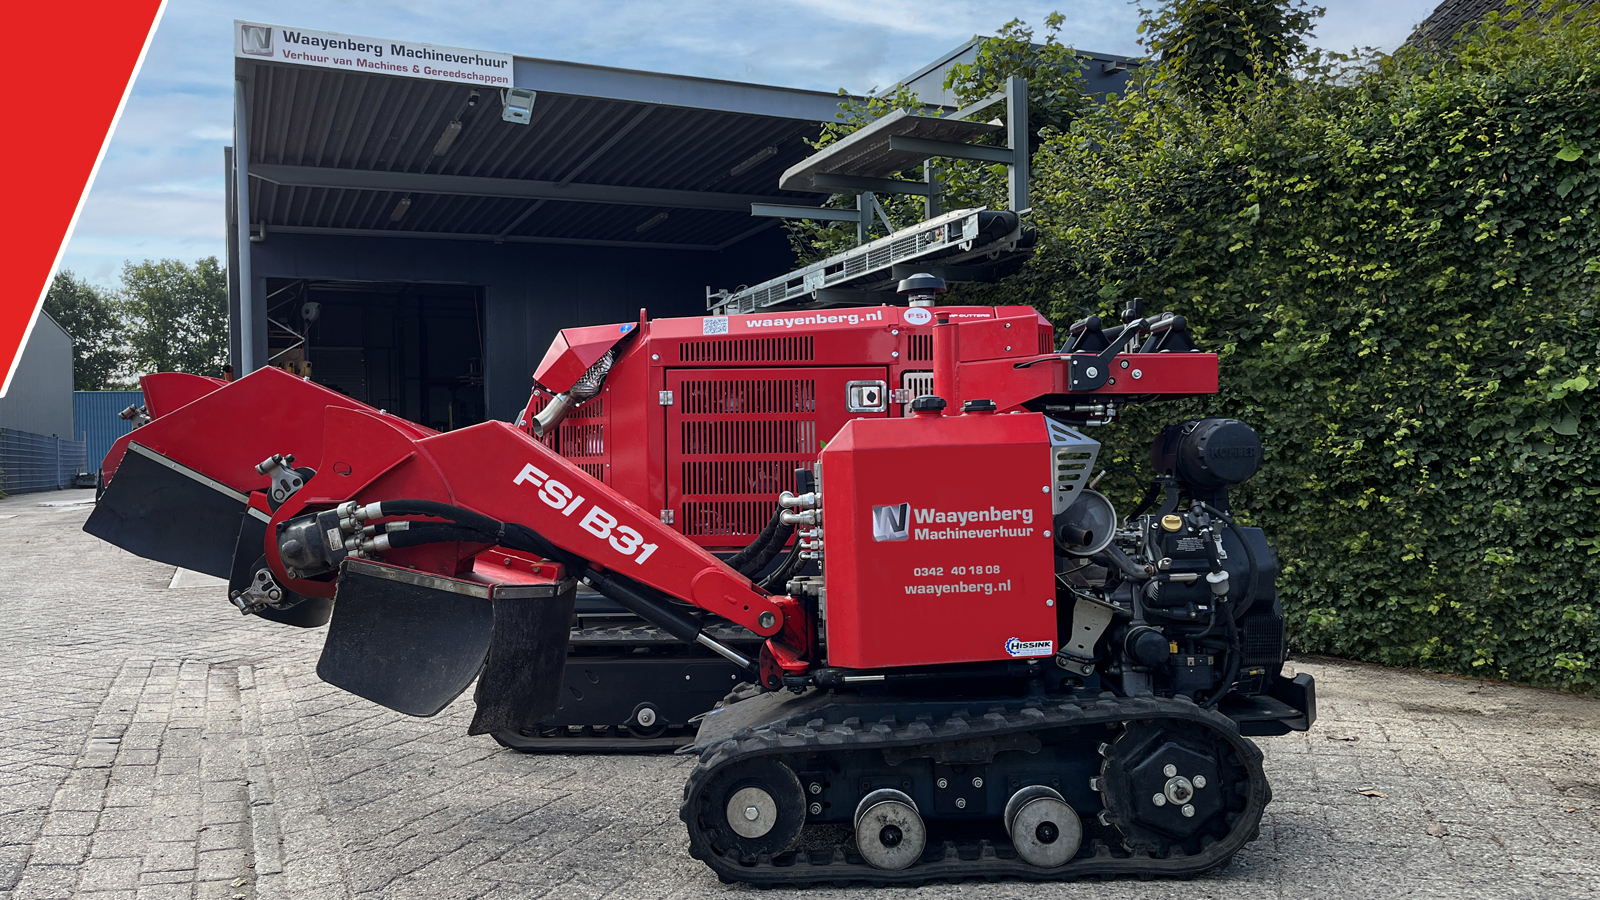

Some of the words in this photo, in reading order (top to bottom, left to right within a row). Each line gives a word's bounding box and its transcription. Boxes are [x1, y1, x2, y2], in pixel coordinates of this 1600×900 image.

[283, 30, 383, 57] Waayenberg
[391, 44, 508, 69] Machineverhuur
[282, 49, 329, 63] Verhuur
[333, 57, 352, 66] van
[357, 58, 408, 72] Machines
[412, 65, 420, 73] &
[424, 66, 509, 84] Gereedschappen
[746, 310, 882, 328] waayenberg.nl
[1210, 446, 1260, 458] KOHLER
[513, 462, 586, 517] FSI
[578, 505, 659, 565] B31
[913, 506, 1034, 527] Waayenberg
[914, 525, 1034, 541] Machineverhuur
[913, 567, 944, 577] 0342
[951, 566, 966, 576] 40
[968, 565, 983, 575] 18
[985, 564, 1001, 574] 08
[904, 579, 1011, 597] waayenberg.nl
[1010, 641, 1051, 650] HISSINK
